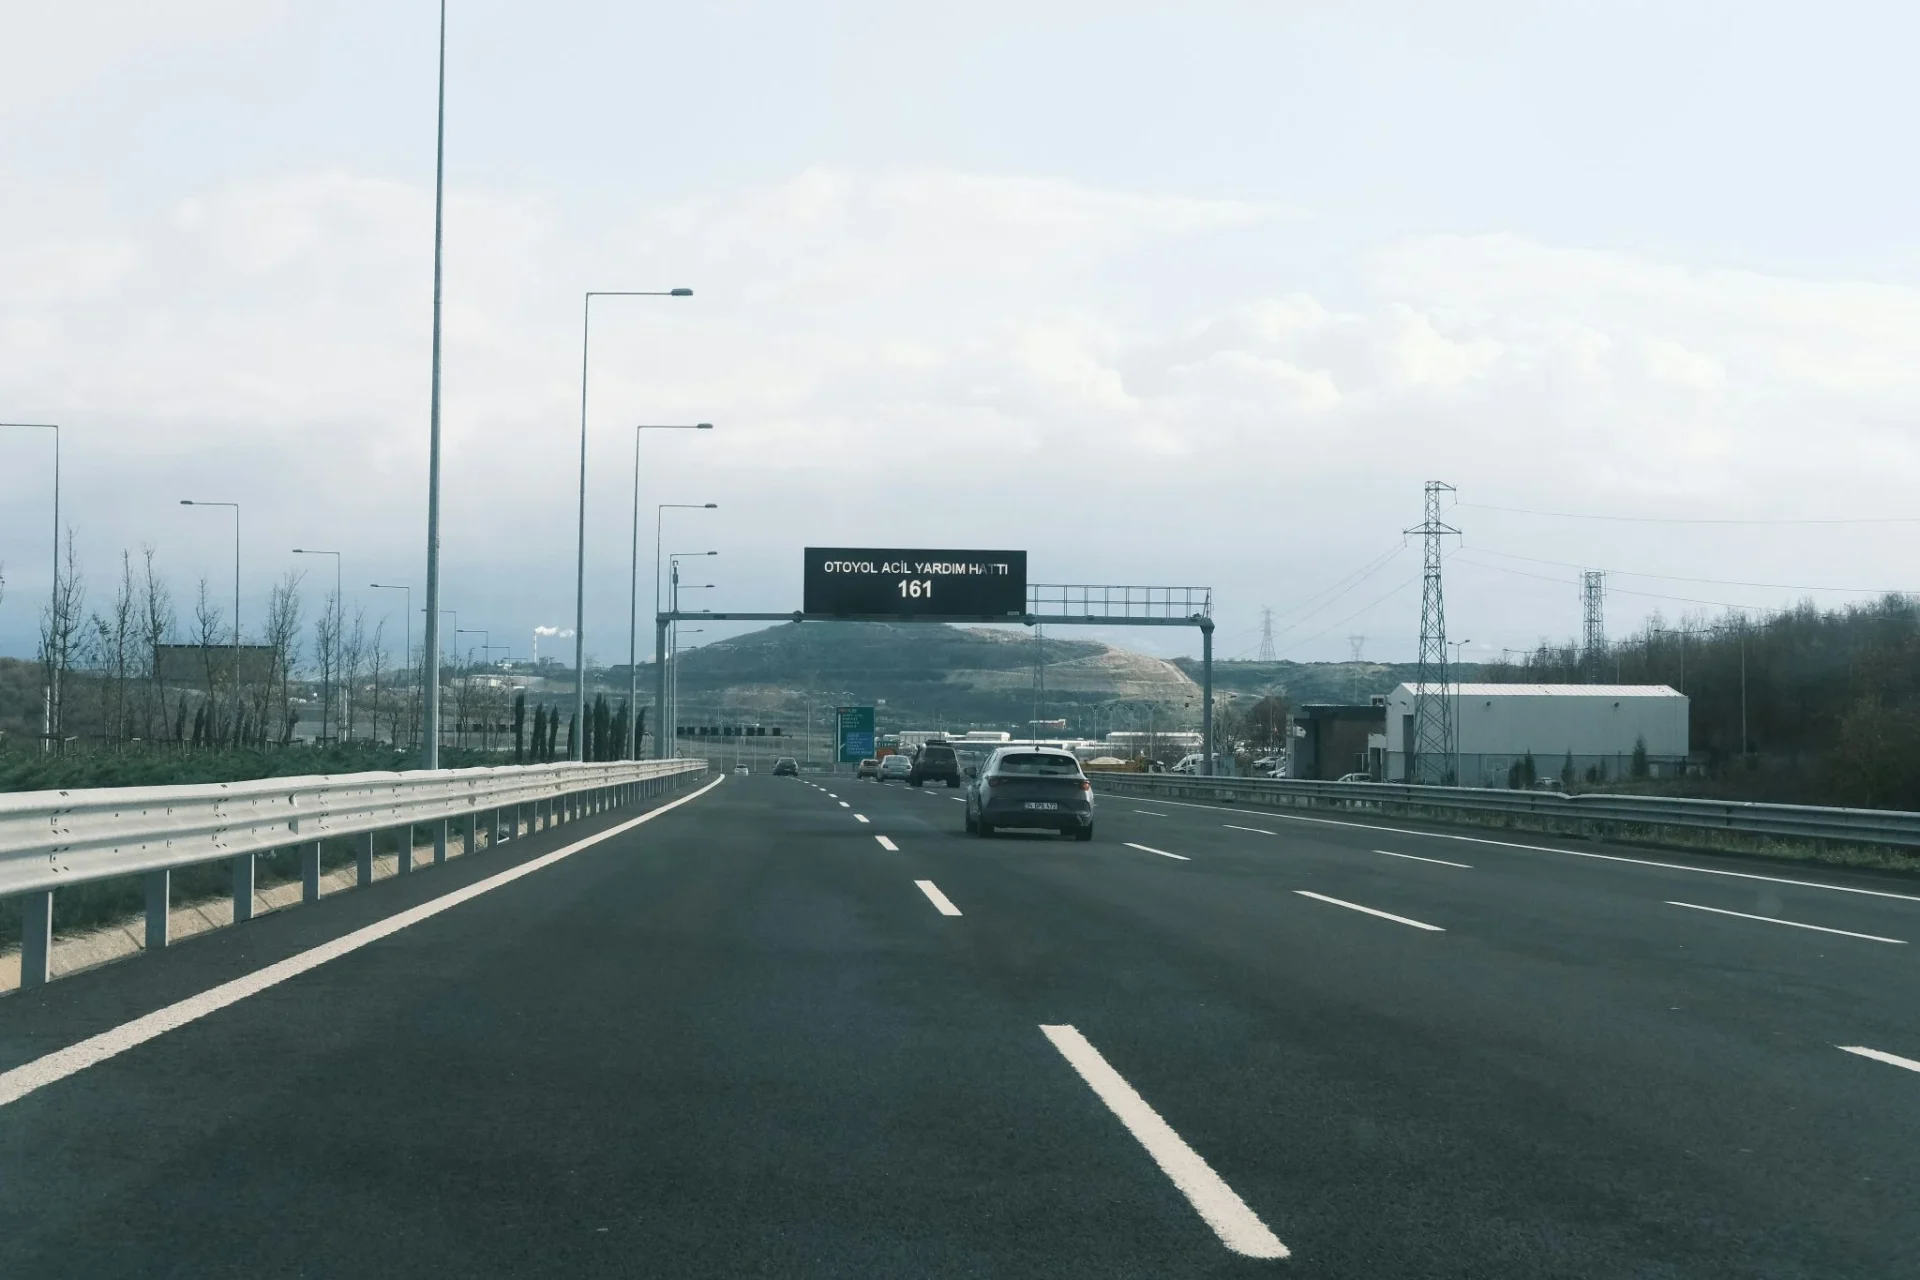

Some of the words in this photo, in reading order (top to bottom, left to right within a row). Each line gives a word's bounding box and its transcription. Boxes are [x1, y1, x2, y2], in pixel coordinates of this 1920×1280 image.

[823, 561, 879, 574] OTOYOL
[881, 559, 912, 574] ACİL
[914, 562, 966, 575] YARDIM
[968, 563, 1009, 576] HATTI
[898, 579, 932, 598] 161
